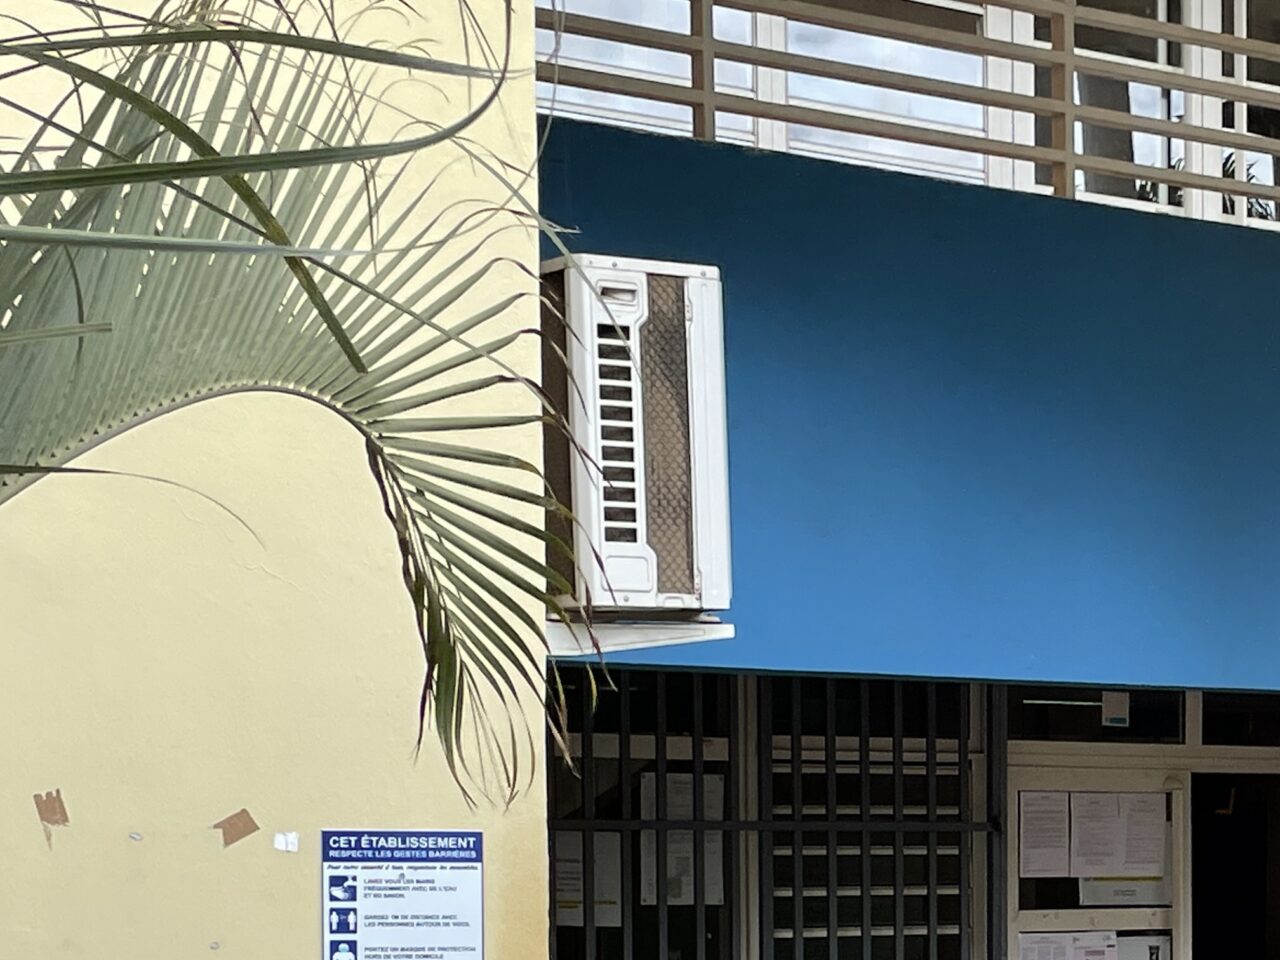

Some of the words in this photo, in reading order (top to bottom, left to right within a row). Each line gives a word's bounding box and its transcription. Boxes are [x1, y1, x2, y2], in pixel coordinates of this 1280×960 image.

[329, 836, 357, 848] CET
[361, 834, 476, 848] ÉTABLISSEMENT
[329, 850, 374, 858] RESPECTE
[375, 850, 391, 858] LES
[393, 850, 427, 858] GESTES
